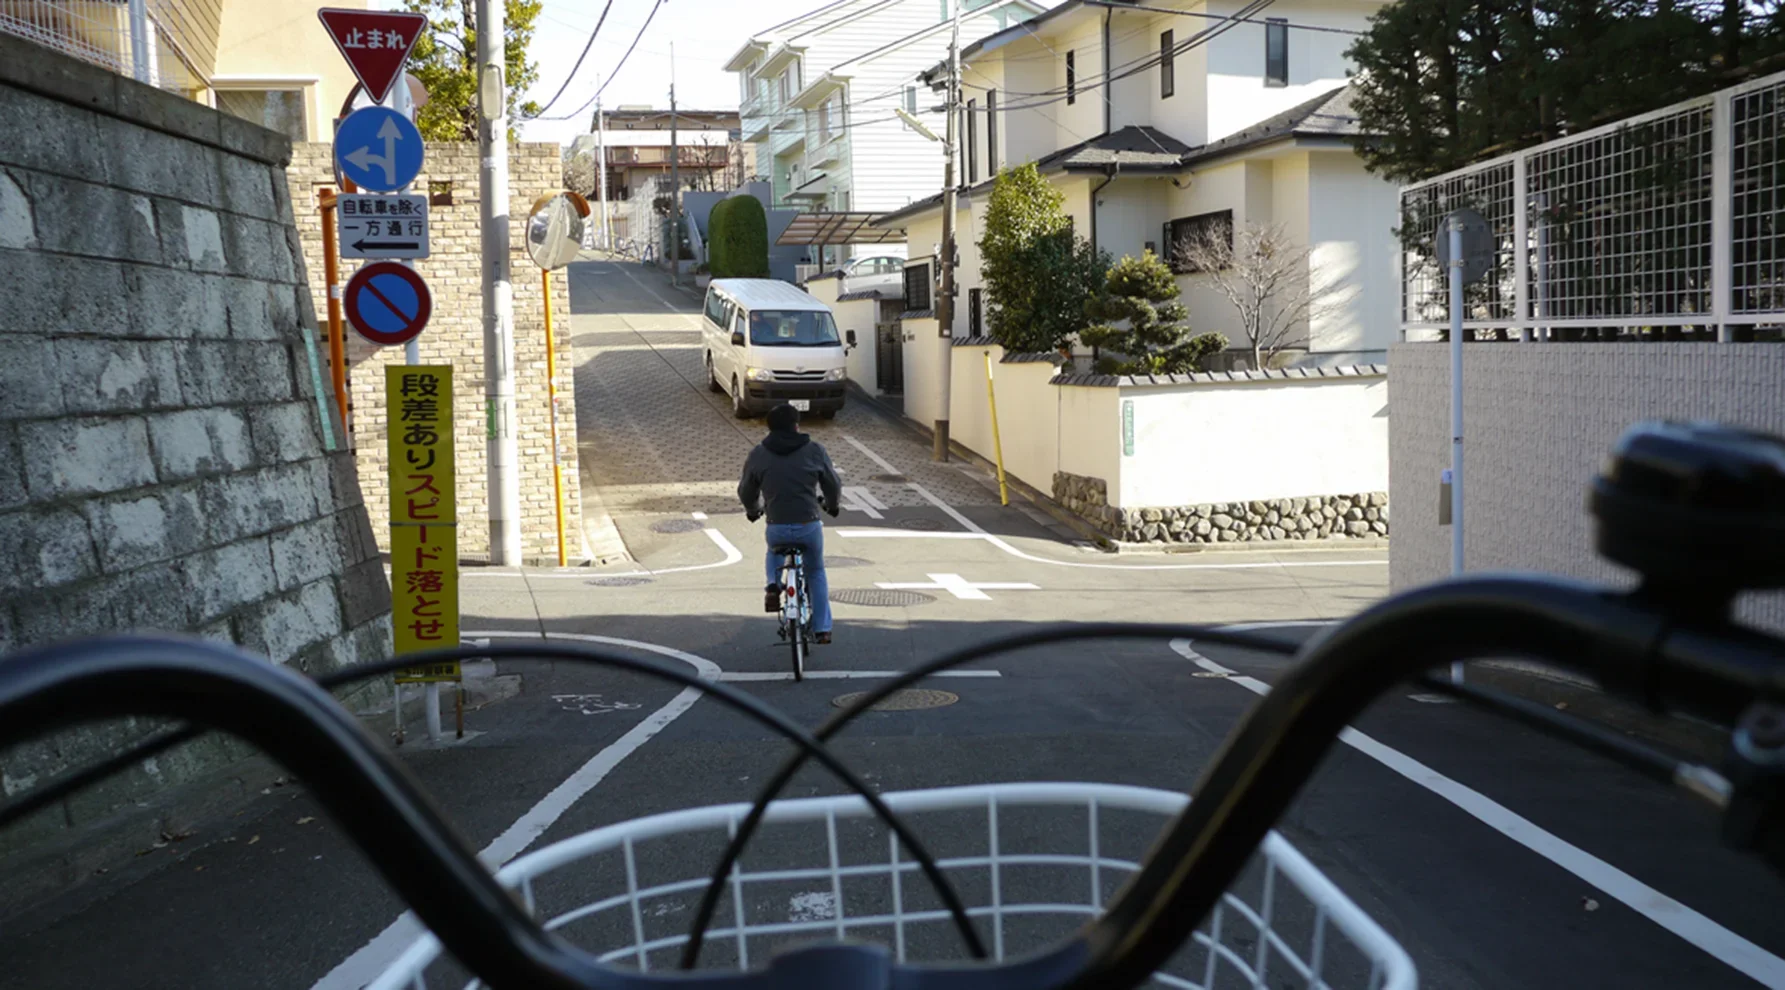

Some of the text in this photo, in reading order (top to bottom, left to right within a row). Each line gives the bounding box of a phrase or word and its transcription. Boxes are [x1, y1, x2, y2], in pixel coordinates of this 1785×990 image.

[343, 26, 407, 50] 止まれ
[343, 198, 423, 215] 自転車を除く
[343, 220, 423, 237] 一方通行
